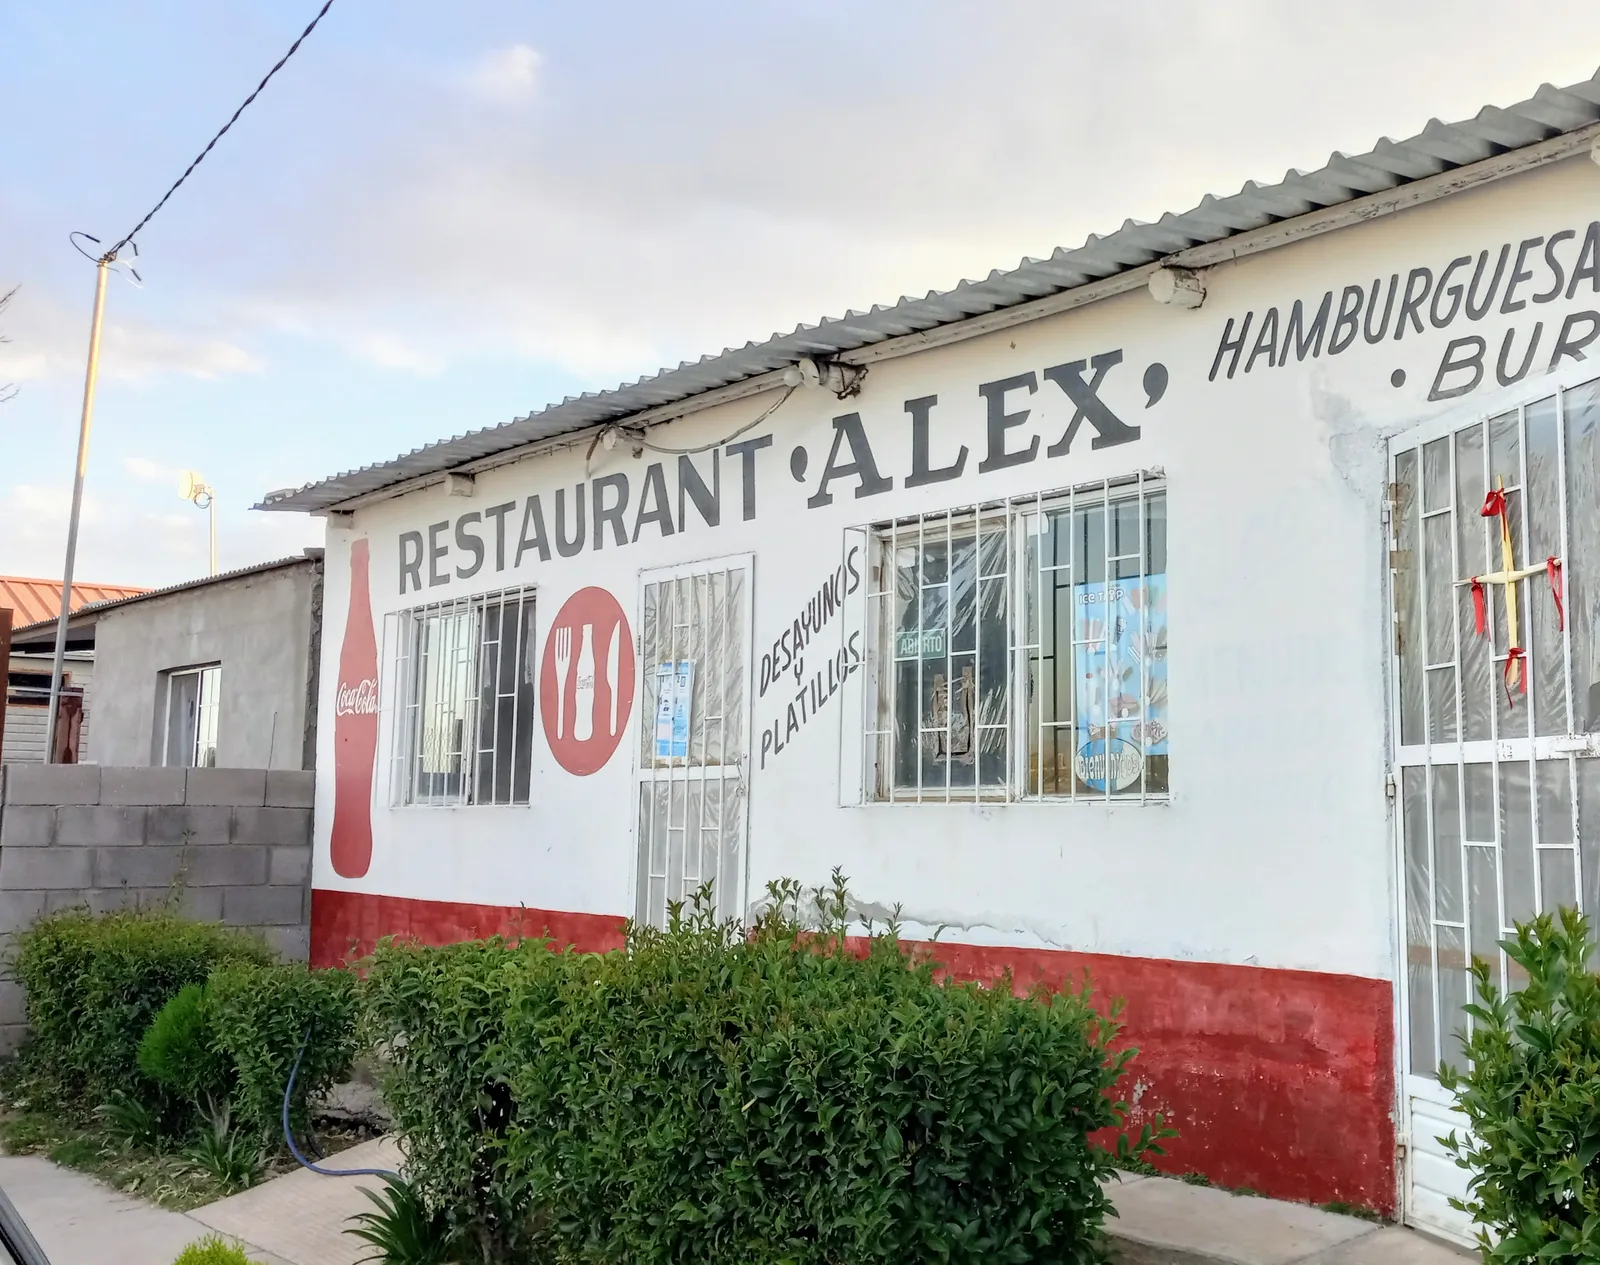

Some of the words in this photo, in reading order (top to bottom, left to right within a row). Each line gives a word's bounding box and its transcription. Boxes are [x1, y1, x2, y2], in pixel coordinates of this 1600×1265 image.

[399, 434, 773, 595] RESTAURANT
[760, 546, 860, 698] DESAYUNOS
[900, 636, 943, 655] ABIRTO
[794, 657, 804, 686] Y
[336, 678, 378, 716] Coca-Cola
[760, 630, 860, 771] PLATILLOS
[1077, 750, 1140, 780] Bienvnidos
